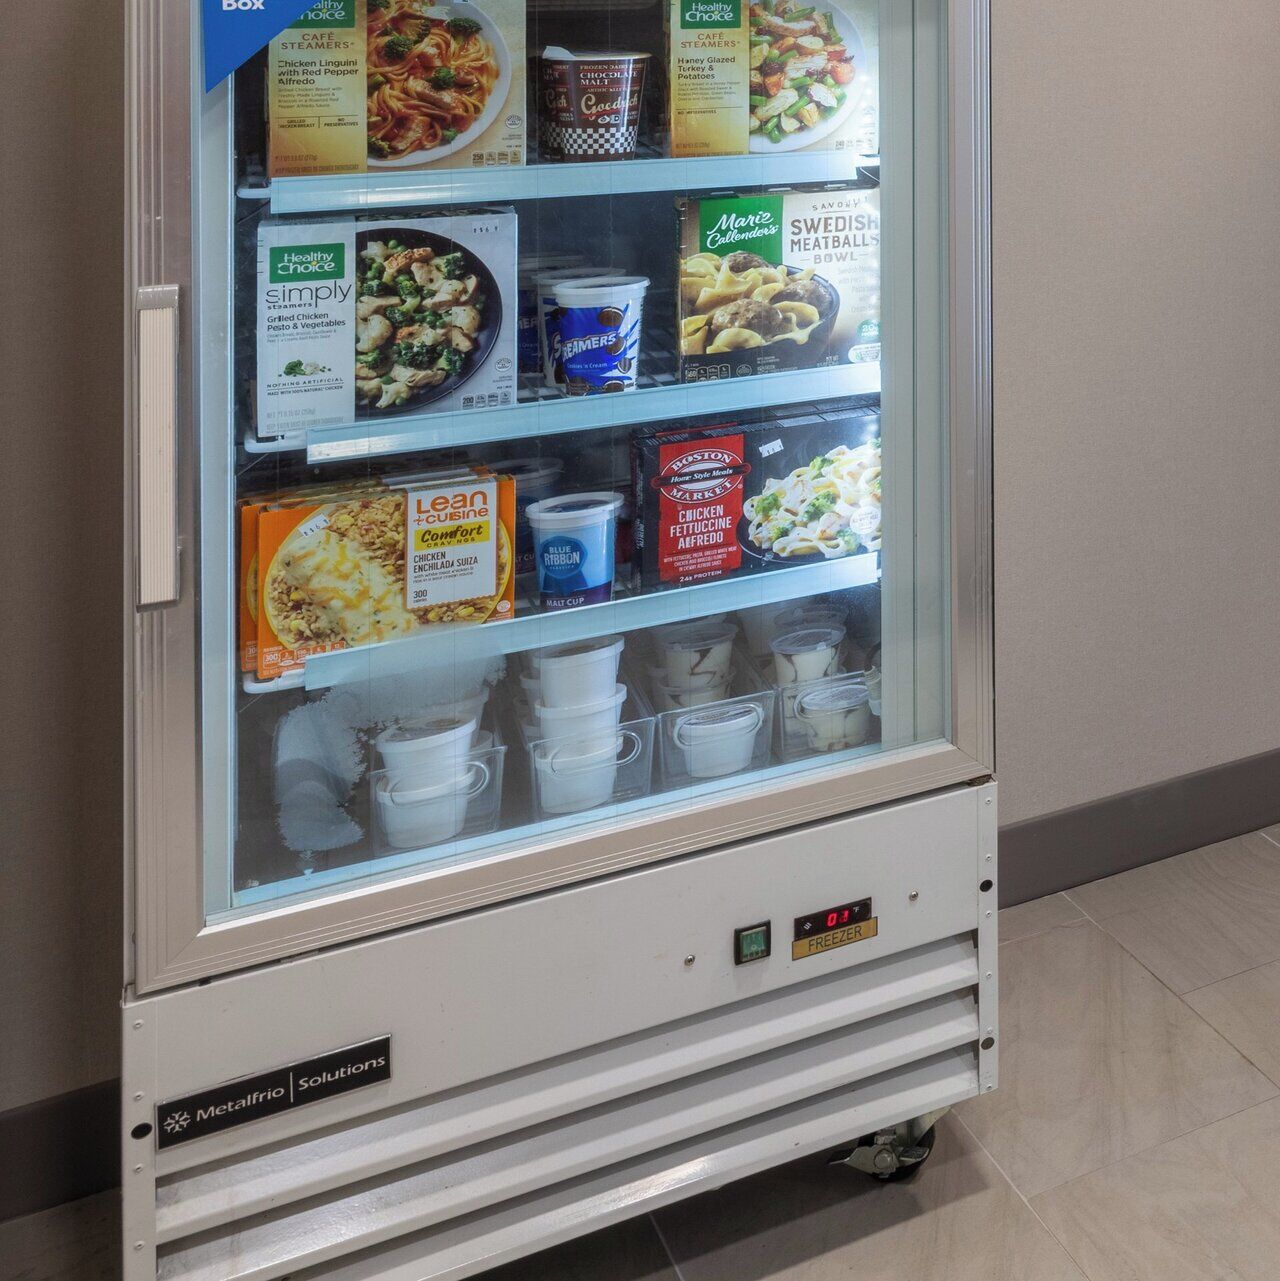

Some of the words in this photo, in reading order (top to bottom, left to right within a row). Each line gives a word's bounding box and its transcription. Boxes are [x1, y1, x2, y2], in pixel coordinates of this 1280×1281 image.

[692, 3, 732, 12] Healthy
[686, 11, 733, 21] Choice
[698, 32, 724, 40] CAFÉ
[320, 59, 358, 68] Linguini
[324, 68, 358, 77] Pepper
[707, 210, 774, 234] Marie
[791, 214, 878, 236] SWEDISH
[707, 224, 780, 249] Callender's
[791, 233, 879, 253] MEATBALLS
[284, 252, 334, 263] Healthy
[814, 252, 858, 264] BOWL
[278, 261, 336, 274] Choice
[266, 280, 352, 308] simply
[267, 314, 294, 323] Grilled
[296, 312, 329, 321] Chicken
[267, 323, 290, 332] Pesto
[300, 319, 346, 330] Vegetables
[671, 452, 732, 471] BOSTON
[671, 475, 692, 483] Home
[693, 473, 711, 481] Style
[670, 480, 732, 500] MARKET
[679, 505, 724, 522] CHICKEN
[421, 524, 484, 543] Comfort
[670, 517, 732, 537] FETTUCCINE
[678, 531, 723, 549] ALFREDO
[549, 545, 571, 555] BLUE
[414, 551, 446, 563] CHICKEN
[544, 552, 580, 566] RIBBON
[414, 562, 454, 573] ENCHILADA
[456, 556, 478, 566] SUIZA
[413, 590, 427, 598] 300
[546, 598, 565, 607] MALT
[567, 596, 584, 606] CUP
[808, 926, 862, 952] FREEZER
[196, 1084, 284, 1122] Metalfrio
[298, 1054, 386, 1092] Solutions
